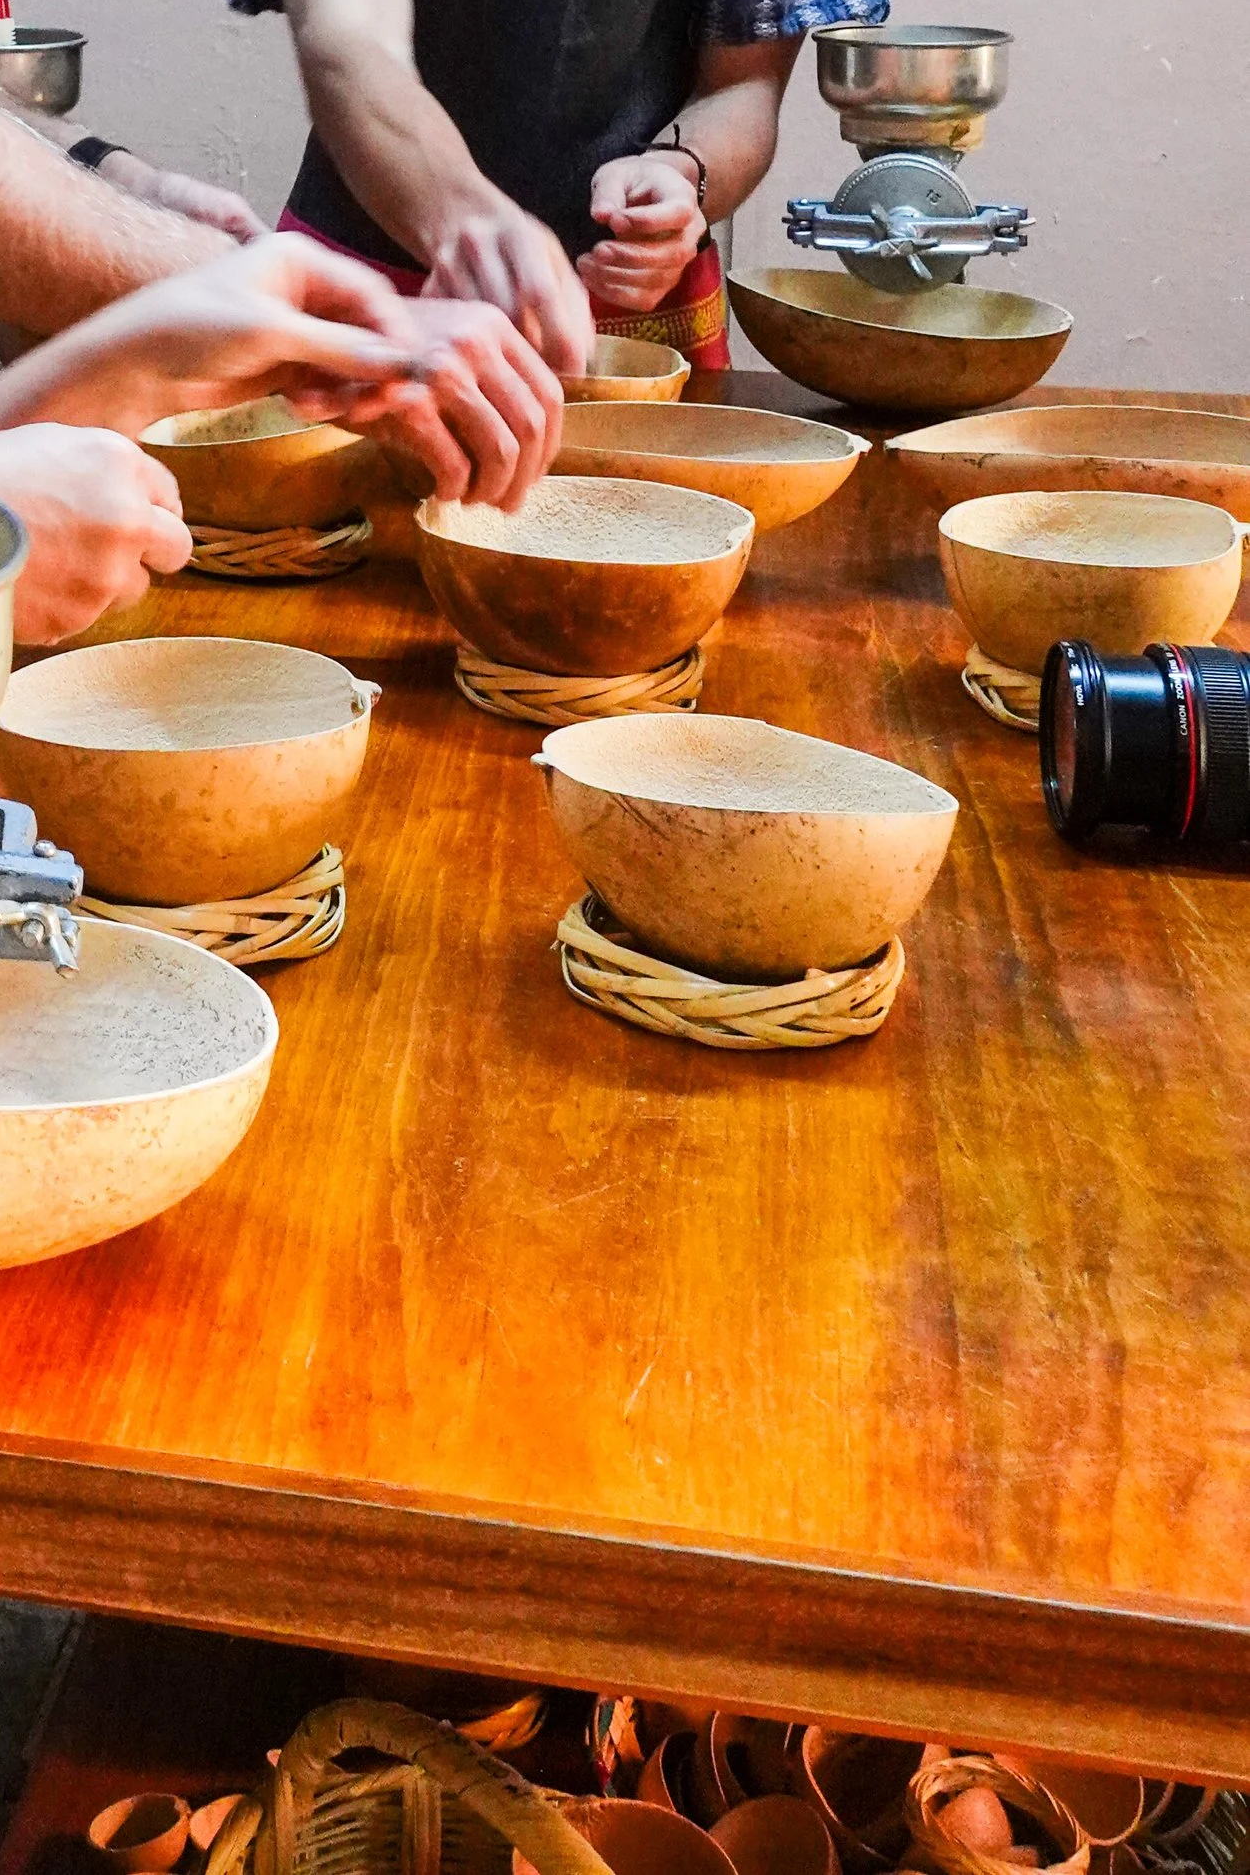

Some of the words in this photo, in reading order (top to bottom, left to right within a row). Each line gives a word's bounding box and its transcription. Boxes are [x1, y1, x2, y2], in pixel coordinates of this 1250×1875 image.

[1169, 660, 1180, 673] LENS
[1075, 685, 1085, 706] HOYA
[1179, 705, 1188, 736] CANON
